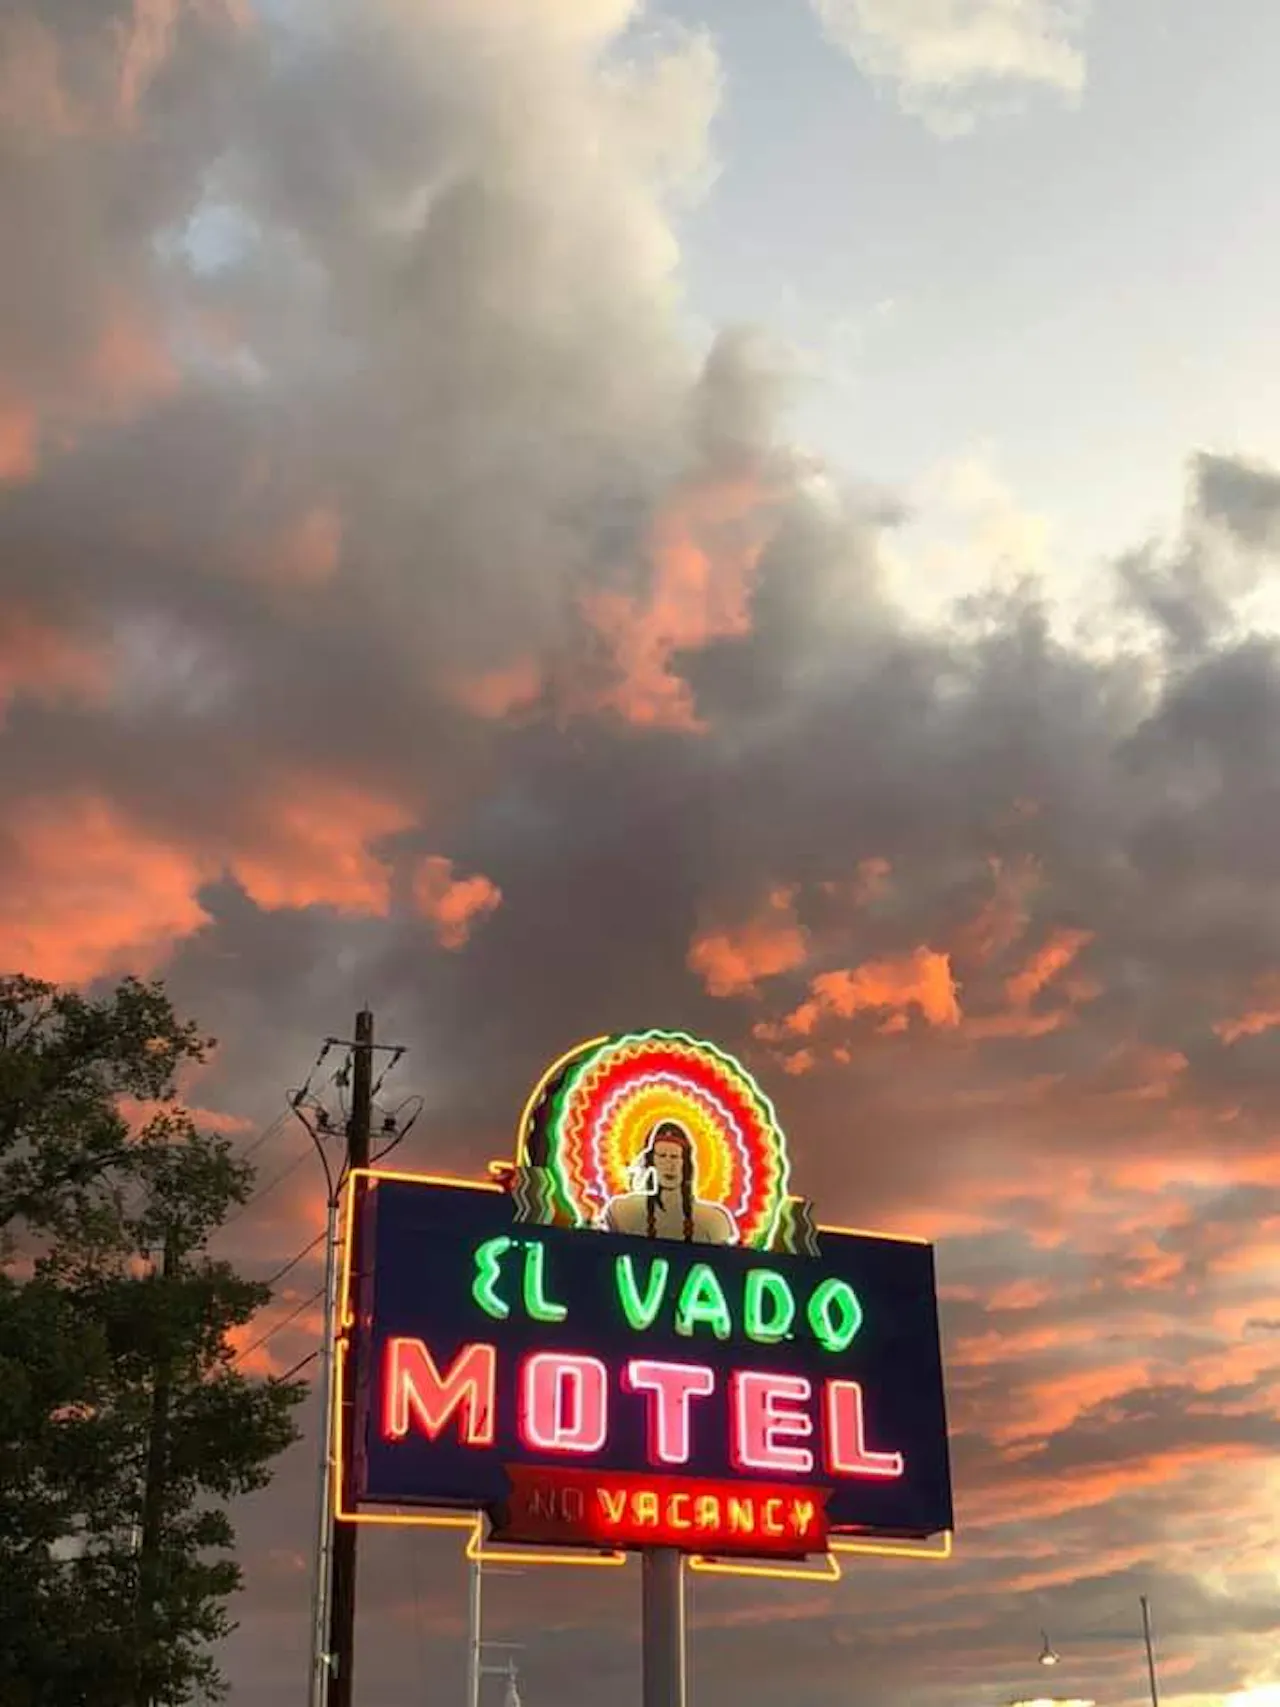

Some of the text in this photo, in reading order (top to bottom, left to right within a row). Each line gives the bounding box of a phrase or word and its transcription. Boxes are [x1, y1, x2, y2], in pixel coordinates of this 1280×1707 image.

[472, 1236, 863, 1352] EL VADO
[385, 1337, 903, 1477] MOTEL
[528, 1486, 815, 1537] NO VACANCY
